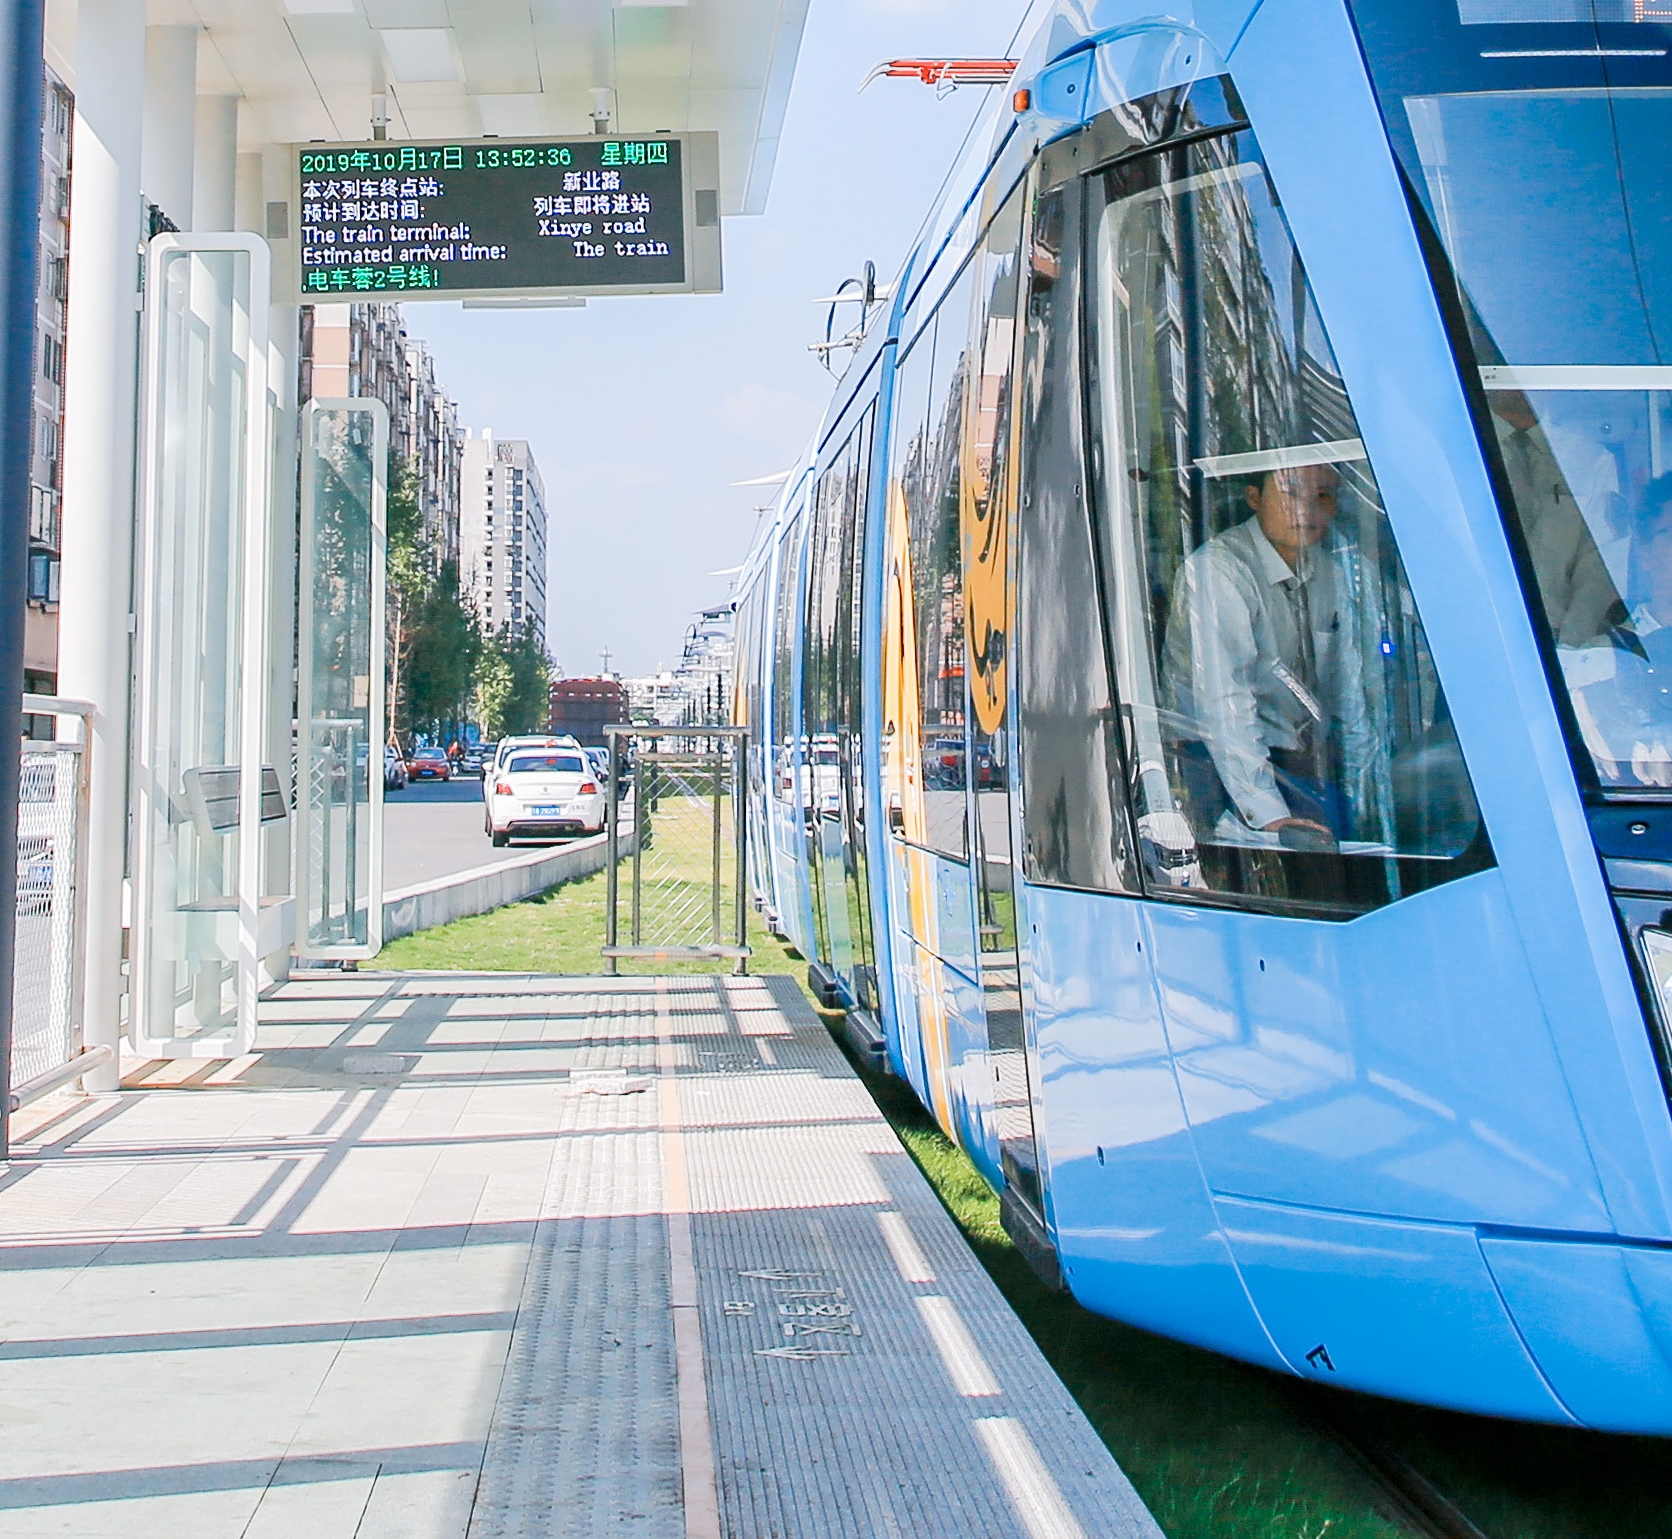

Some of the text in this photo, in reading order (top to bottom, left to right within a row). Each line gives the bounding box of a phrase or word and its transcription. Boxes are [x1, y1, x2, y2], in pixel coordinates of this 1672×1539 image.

[301, 141, 669, 173] 2019年10月17日 13:52:36 星期四
[302, 170, 622, 201] 本次列车终点站: 新业路
[303, 192, 651, 223] 预计到达时间: 列车即将进站
[301, 217, 647, 244] The train terminal: Xinye road
[302, 238, 670, 266] Estimated arrival time: The train
[302, 264, 441, 292] 电车蓉2号线!
